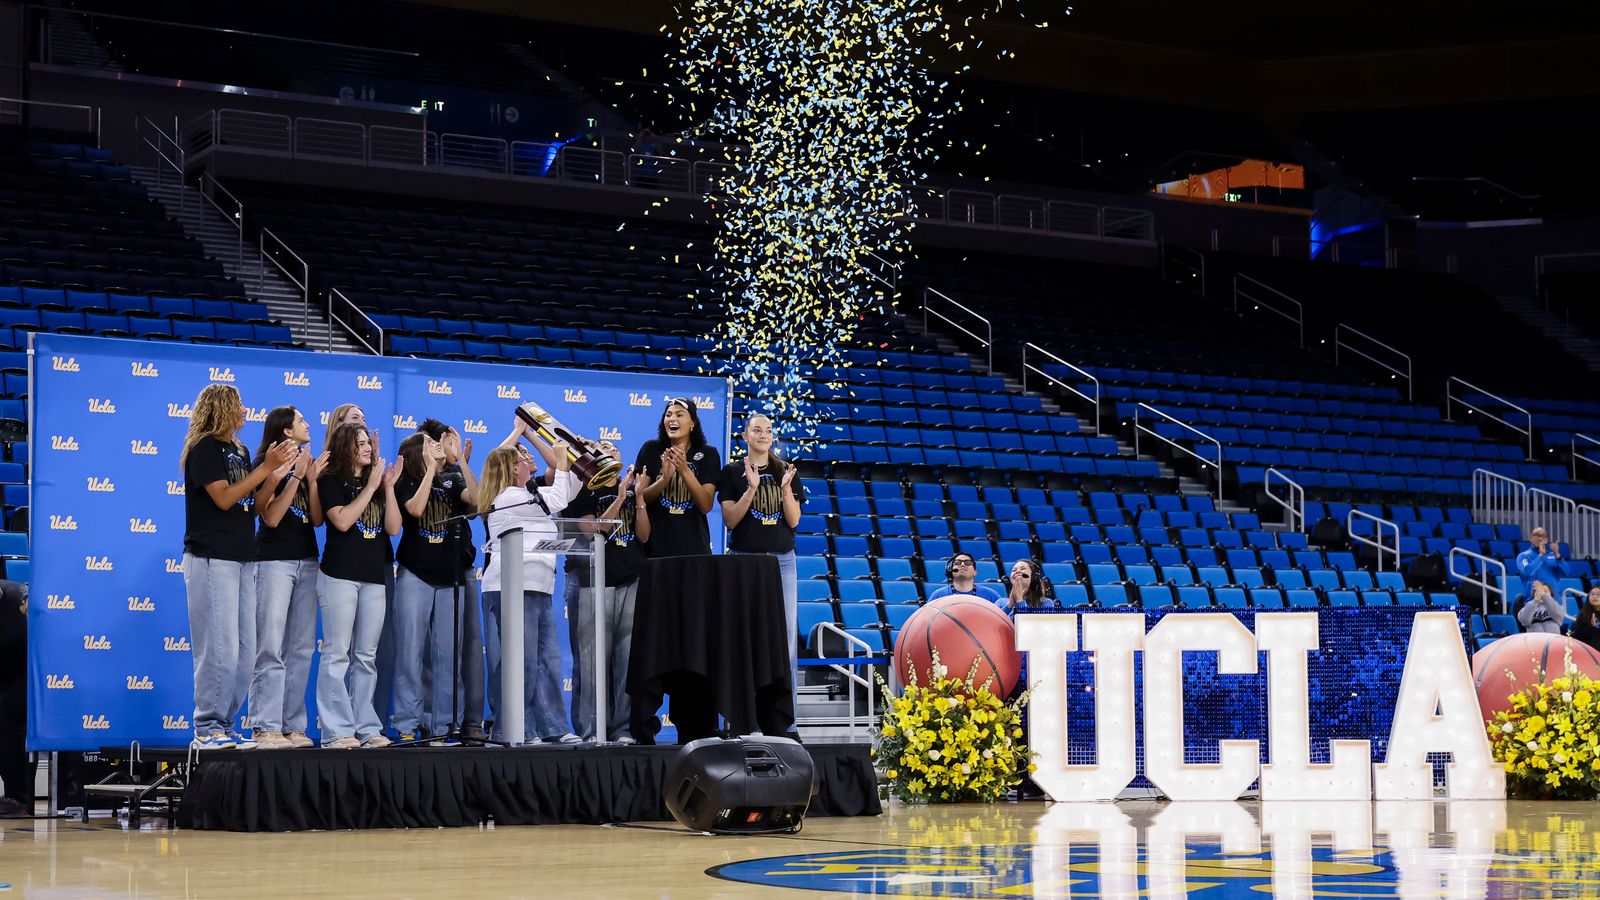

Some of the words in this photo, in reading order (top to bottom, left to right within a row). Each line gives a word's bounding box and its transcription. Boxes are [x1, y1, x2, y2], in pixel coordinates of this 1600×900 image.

[421, 100, 444, 111] EIT
[1224, 193, 1241, 202] EXIT
[53, 357, 80, 371] Ucla
[132, 363, 158, 377] Ucla
[210, 368, 235, 382] Ucla
[285, 372, 310, 386] Ucla
[358, 376, 382, 390] Ucla
[429, 381, 452, 394] Ucla
[497, 386, 520, 399] Ucla
[565, 390, 587, 403] Ucla
[630, 393, 652, 406] Ucla
[89, 399, 115, 413] Ucla
[693, 396, 714, 409] Ucla
[394, 415, 417, 429] Ucla
[464, 420, 487, 433] Ucla
[599, 427, 622, 440] Ucla
[52, 436, 79, 450] Ucla
[132, 441, 158, 454] Ucla
[88, 478, 114, 492] Ucla
[51, 516, 78, 529] Ucla
[130, 519, 157, 533] Ucla
[86, 557, 112, 571] Ucla
[48, 595, 75, 609] Ucla
[129, 597, 155, 611] Ucla
[84, 636, 111, 650] Ucla
[165, 637, 190, 651] Ucla
[47, 675, 74, 689] Ucla
[127, 676, 153, 690] Ucla
[1015, 612, 1506, 801] UCLA
[83, 716, 110, 729] Ucla
[163, 716, 189, 729] Ucla
